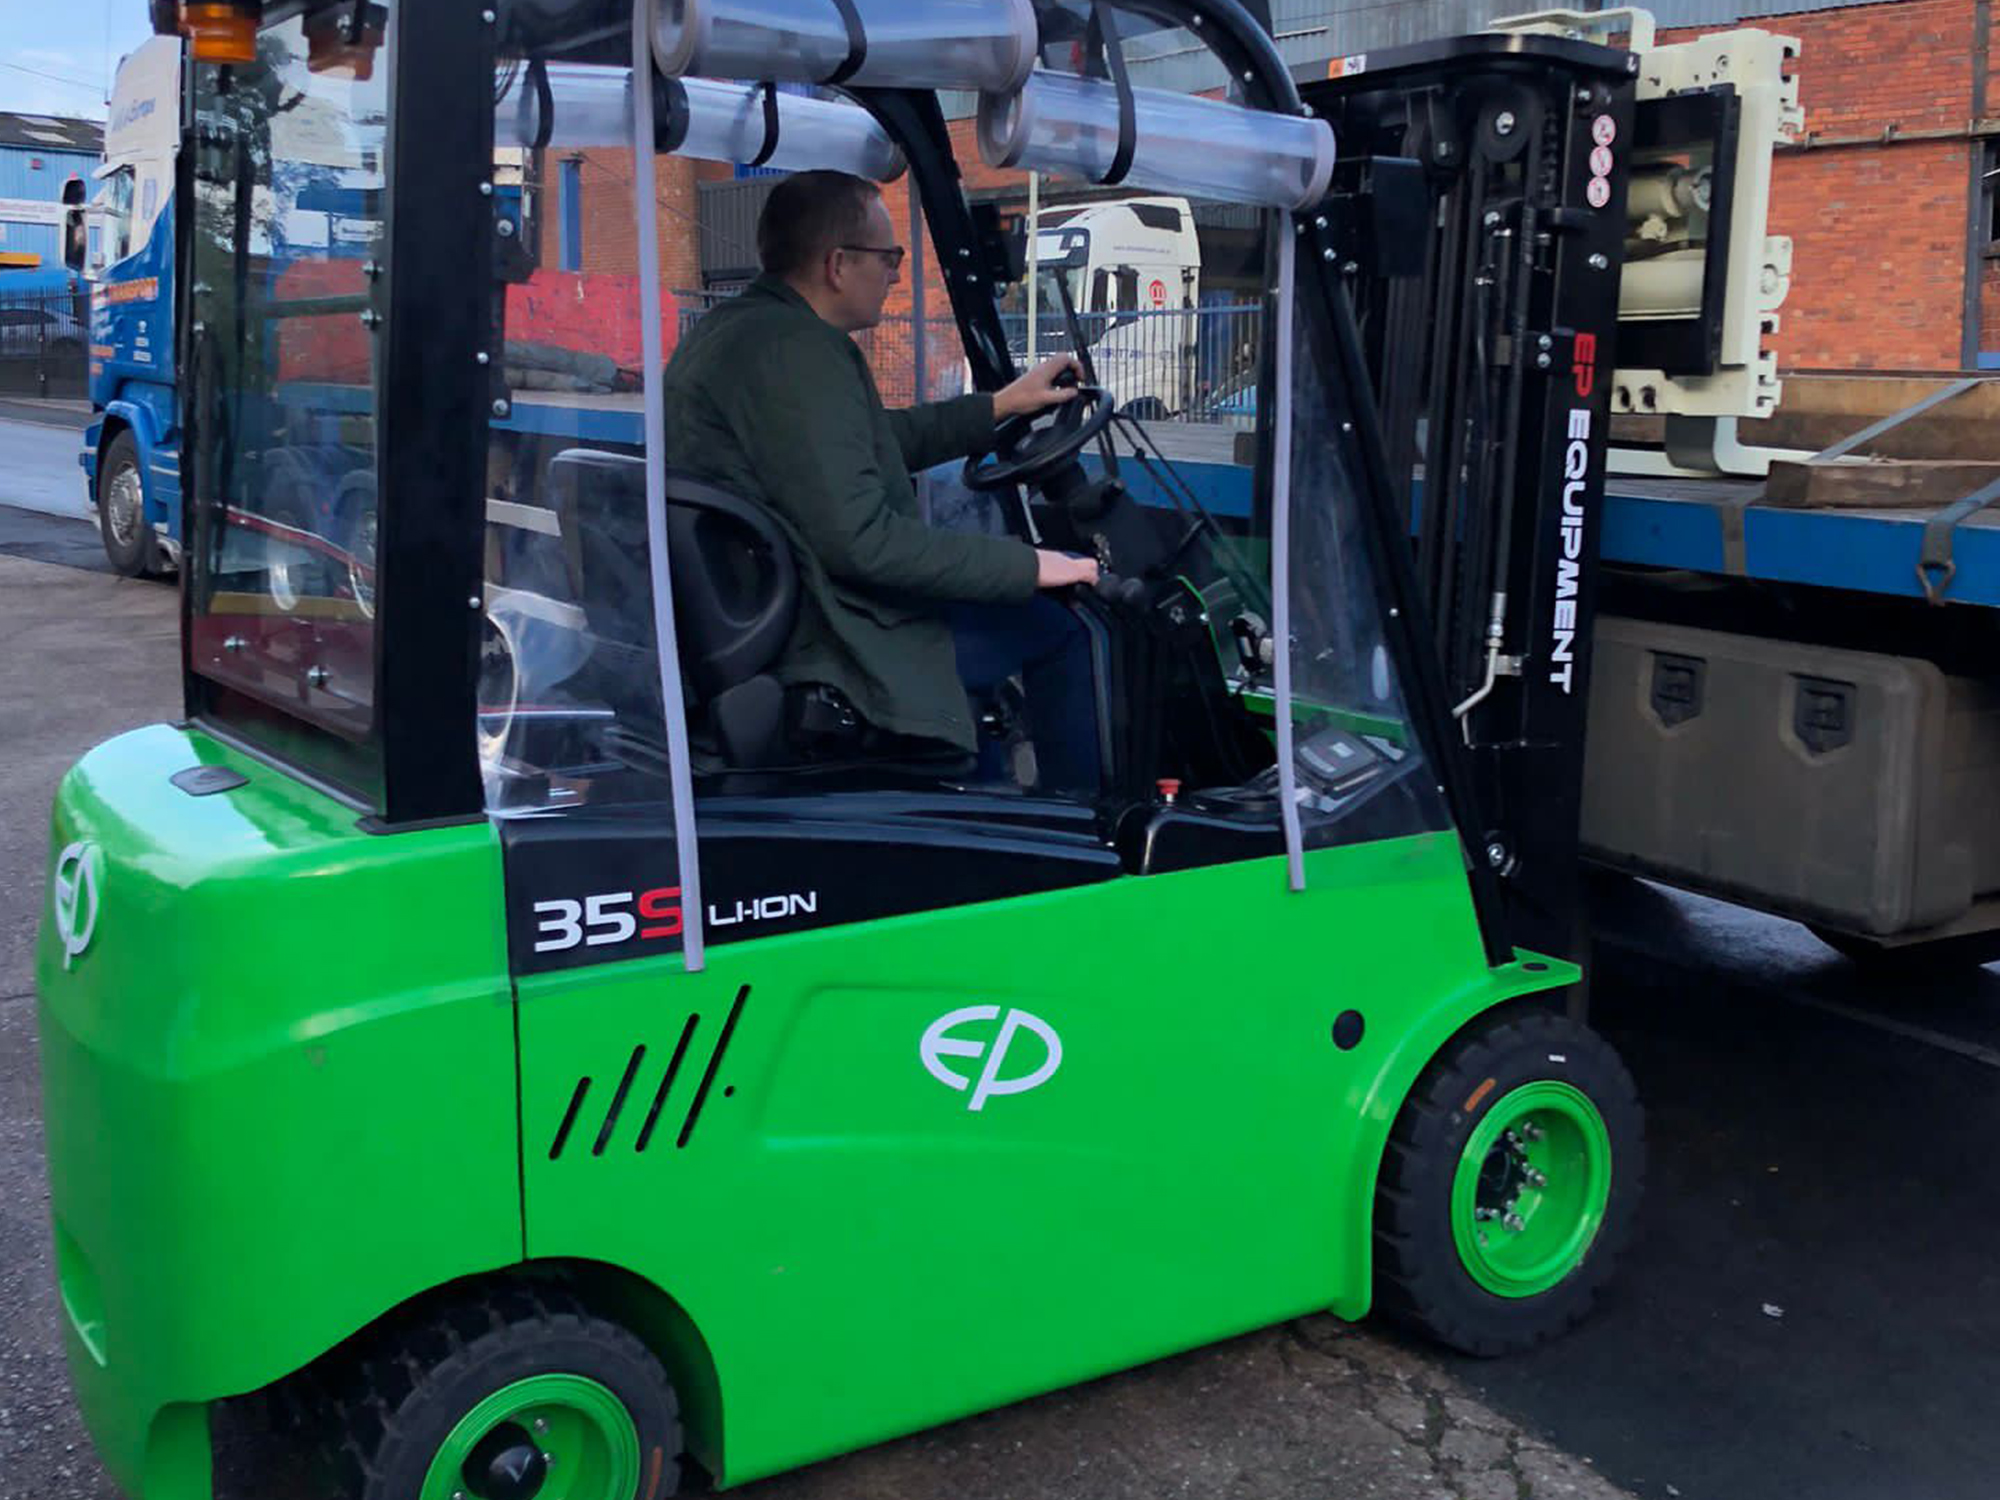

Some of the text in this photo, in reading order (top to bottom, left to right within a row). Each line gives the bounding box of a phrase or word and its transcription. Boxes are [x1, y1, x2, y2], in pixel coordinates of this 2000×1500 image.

[1550, 332, 1596, 693] EP EQUIPMENT
[533, 886, 817, 952] 35S LI-ION
[919, 1004, 1063, 1112] EP
